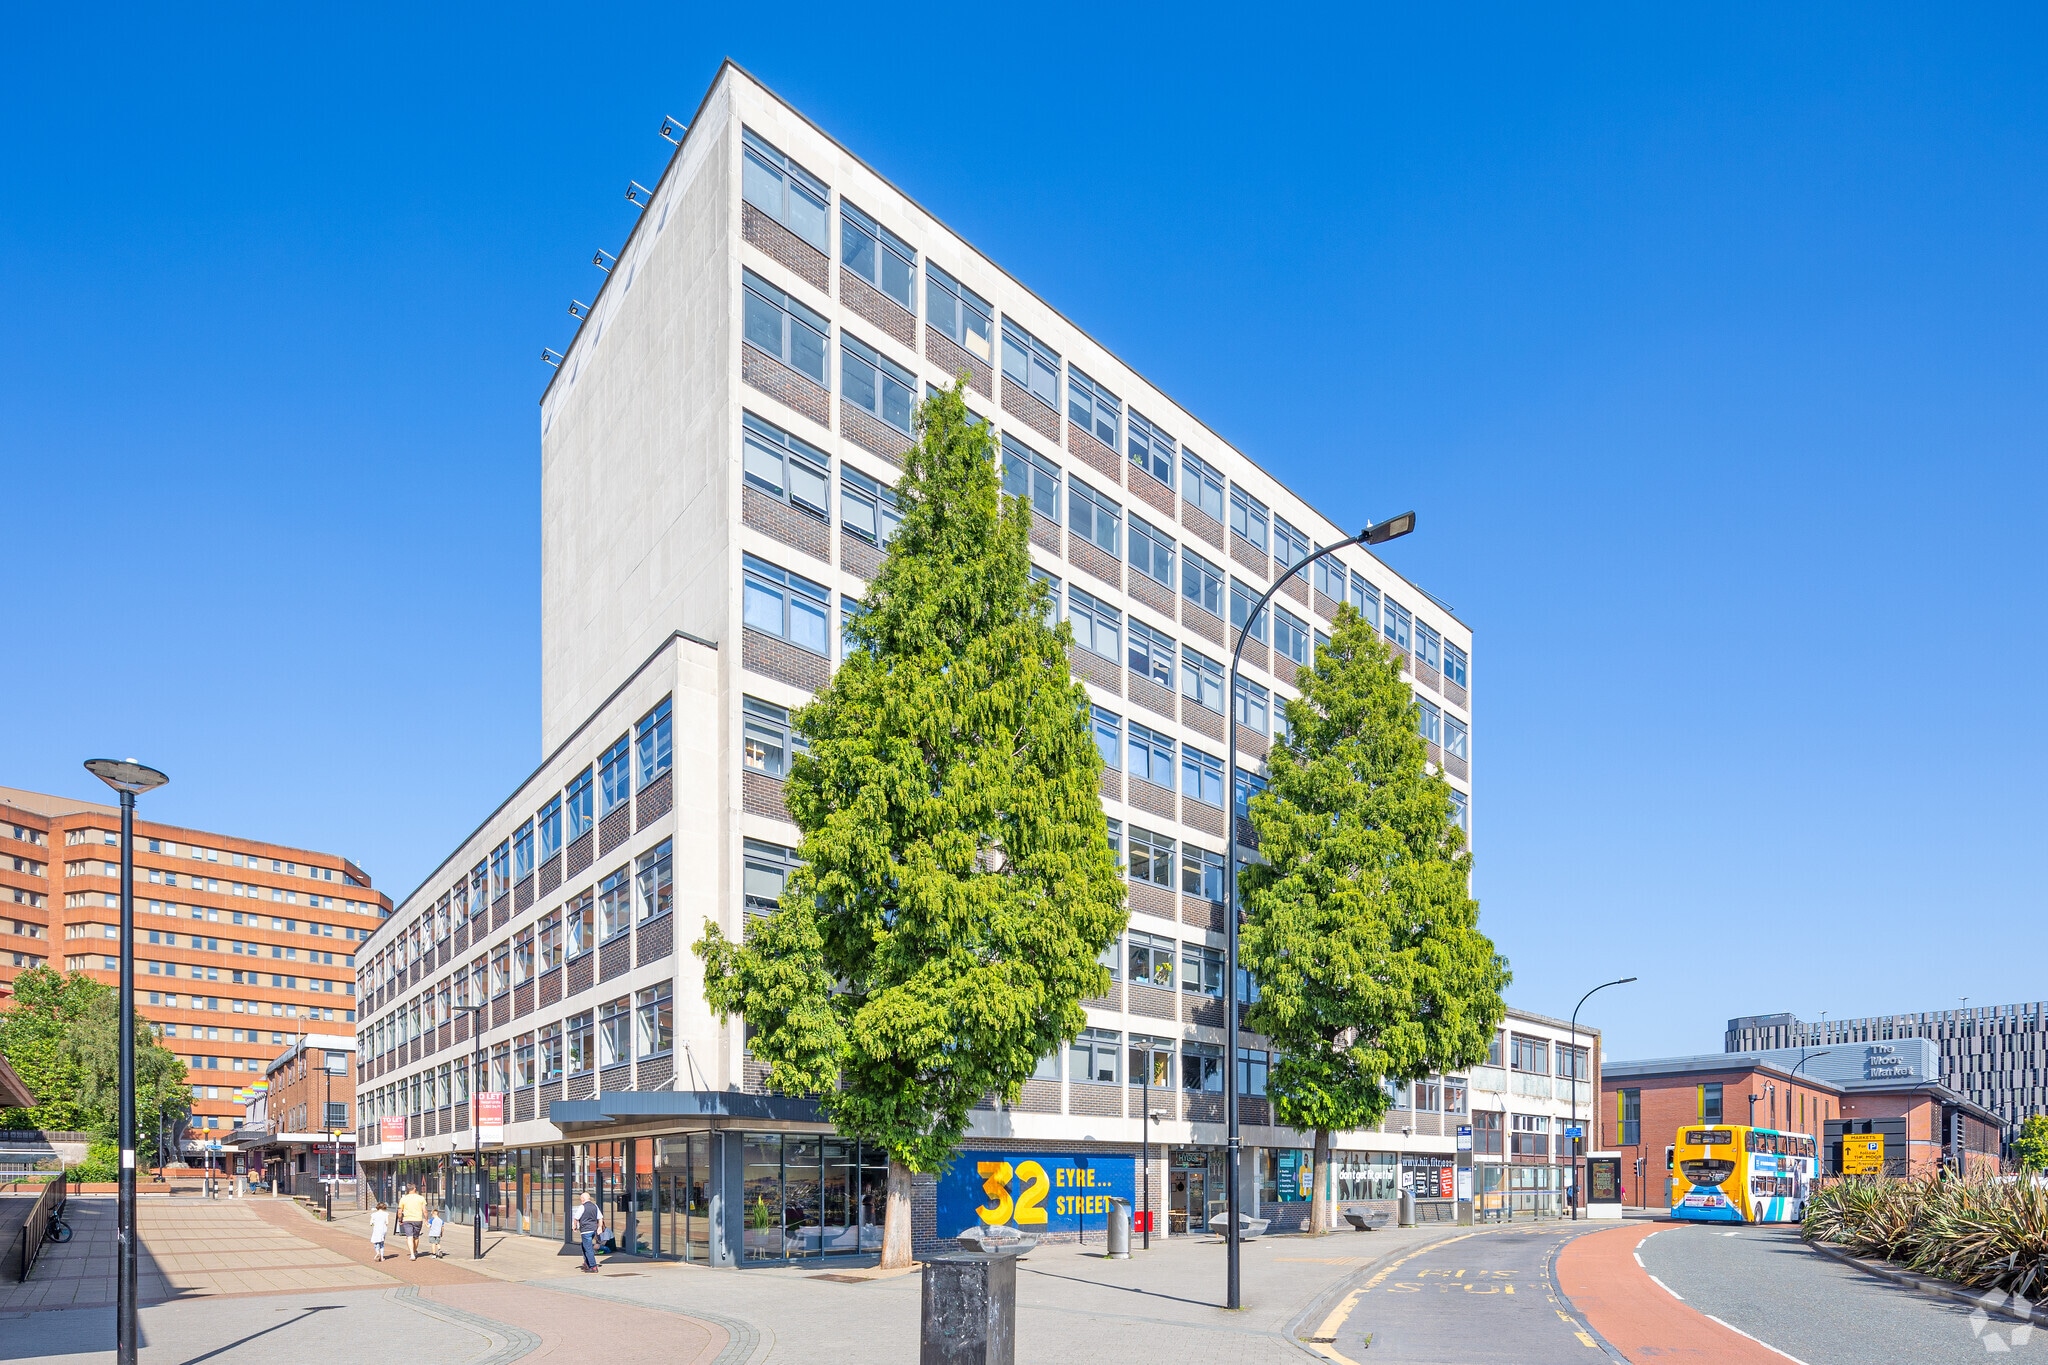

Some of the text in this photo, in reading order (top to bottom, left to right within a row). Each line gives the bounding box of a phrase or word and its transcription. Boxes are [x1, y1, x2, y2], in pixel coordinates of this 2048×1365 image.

[1870, 1045, 1895, 1054] The
[1870, 1056, 1903, 1065] Moor
[1870, 1066, 1914, 1077] Market
[975, 1160, 1050, 1226] 32
[1056, 1195, 1111, 1215] STREET
